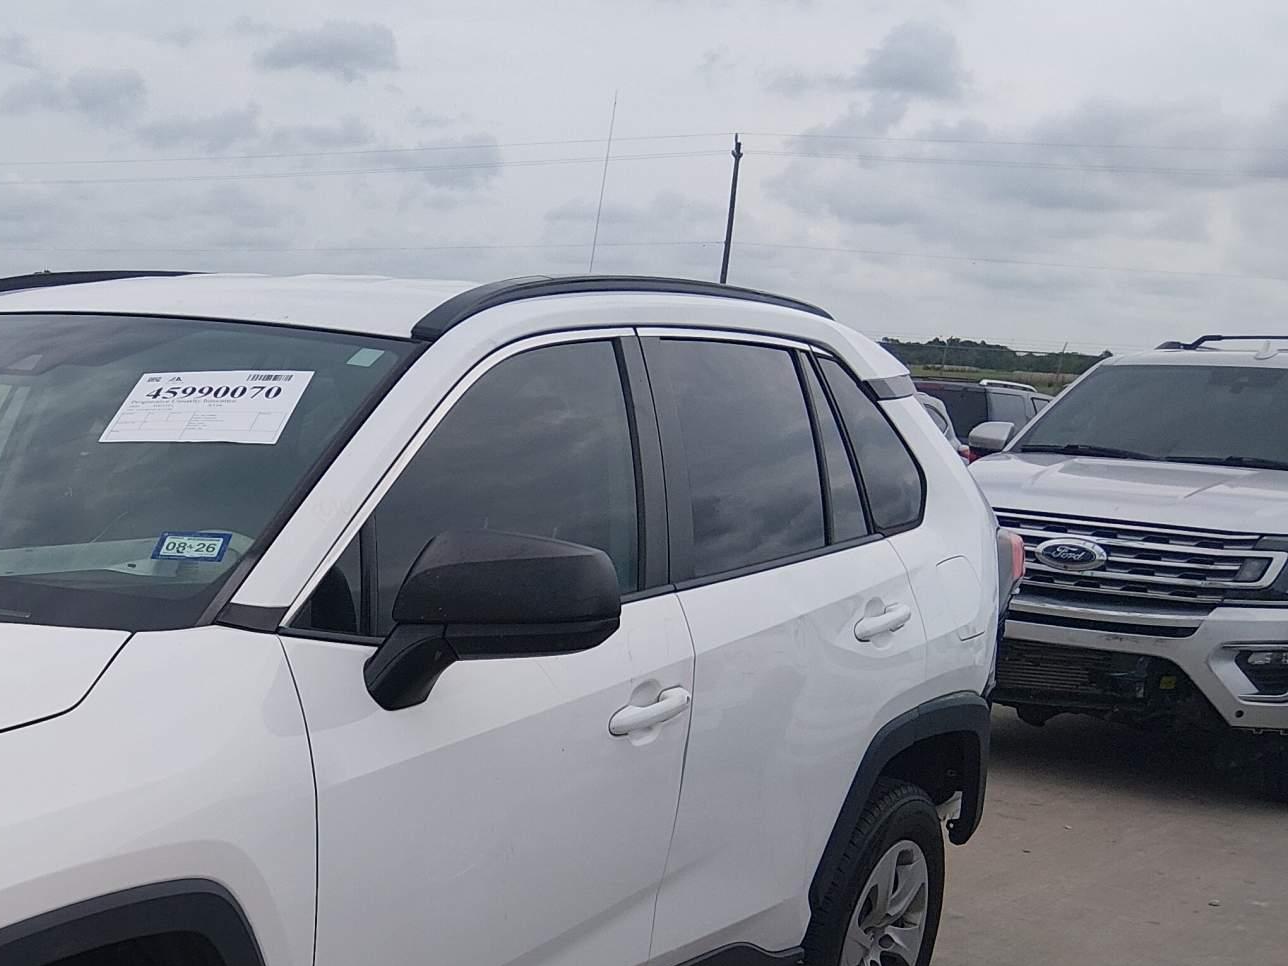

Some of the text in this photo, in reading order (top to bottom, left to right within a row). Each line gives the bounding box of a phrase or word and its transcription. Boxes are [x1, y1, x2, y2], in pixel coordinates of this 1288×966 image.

[145, 385, 283, 400] 45990070
[165, 541, 217, 554] 08 26
[1052, 545, 1086, 561] Ford
